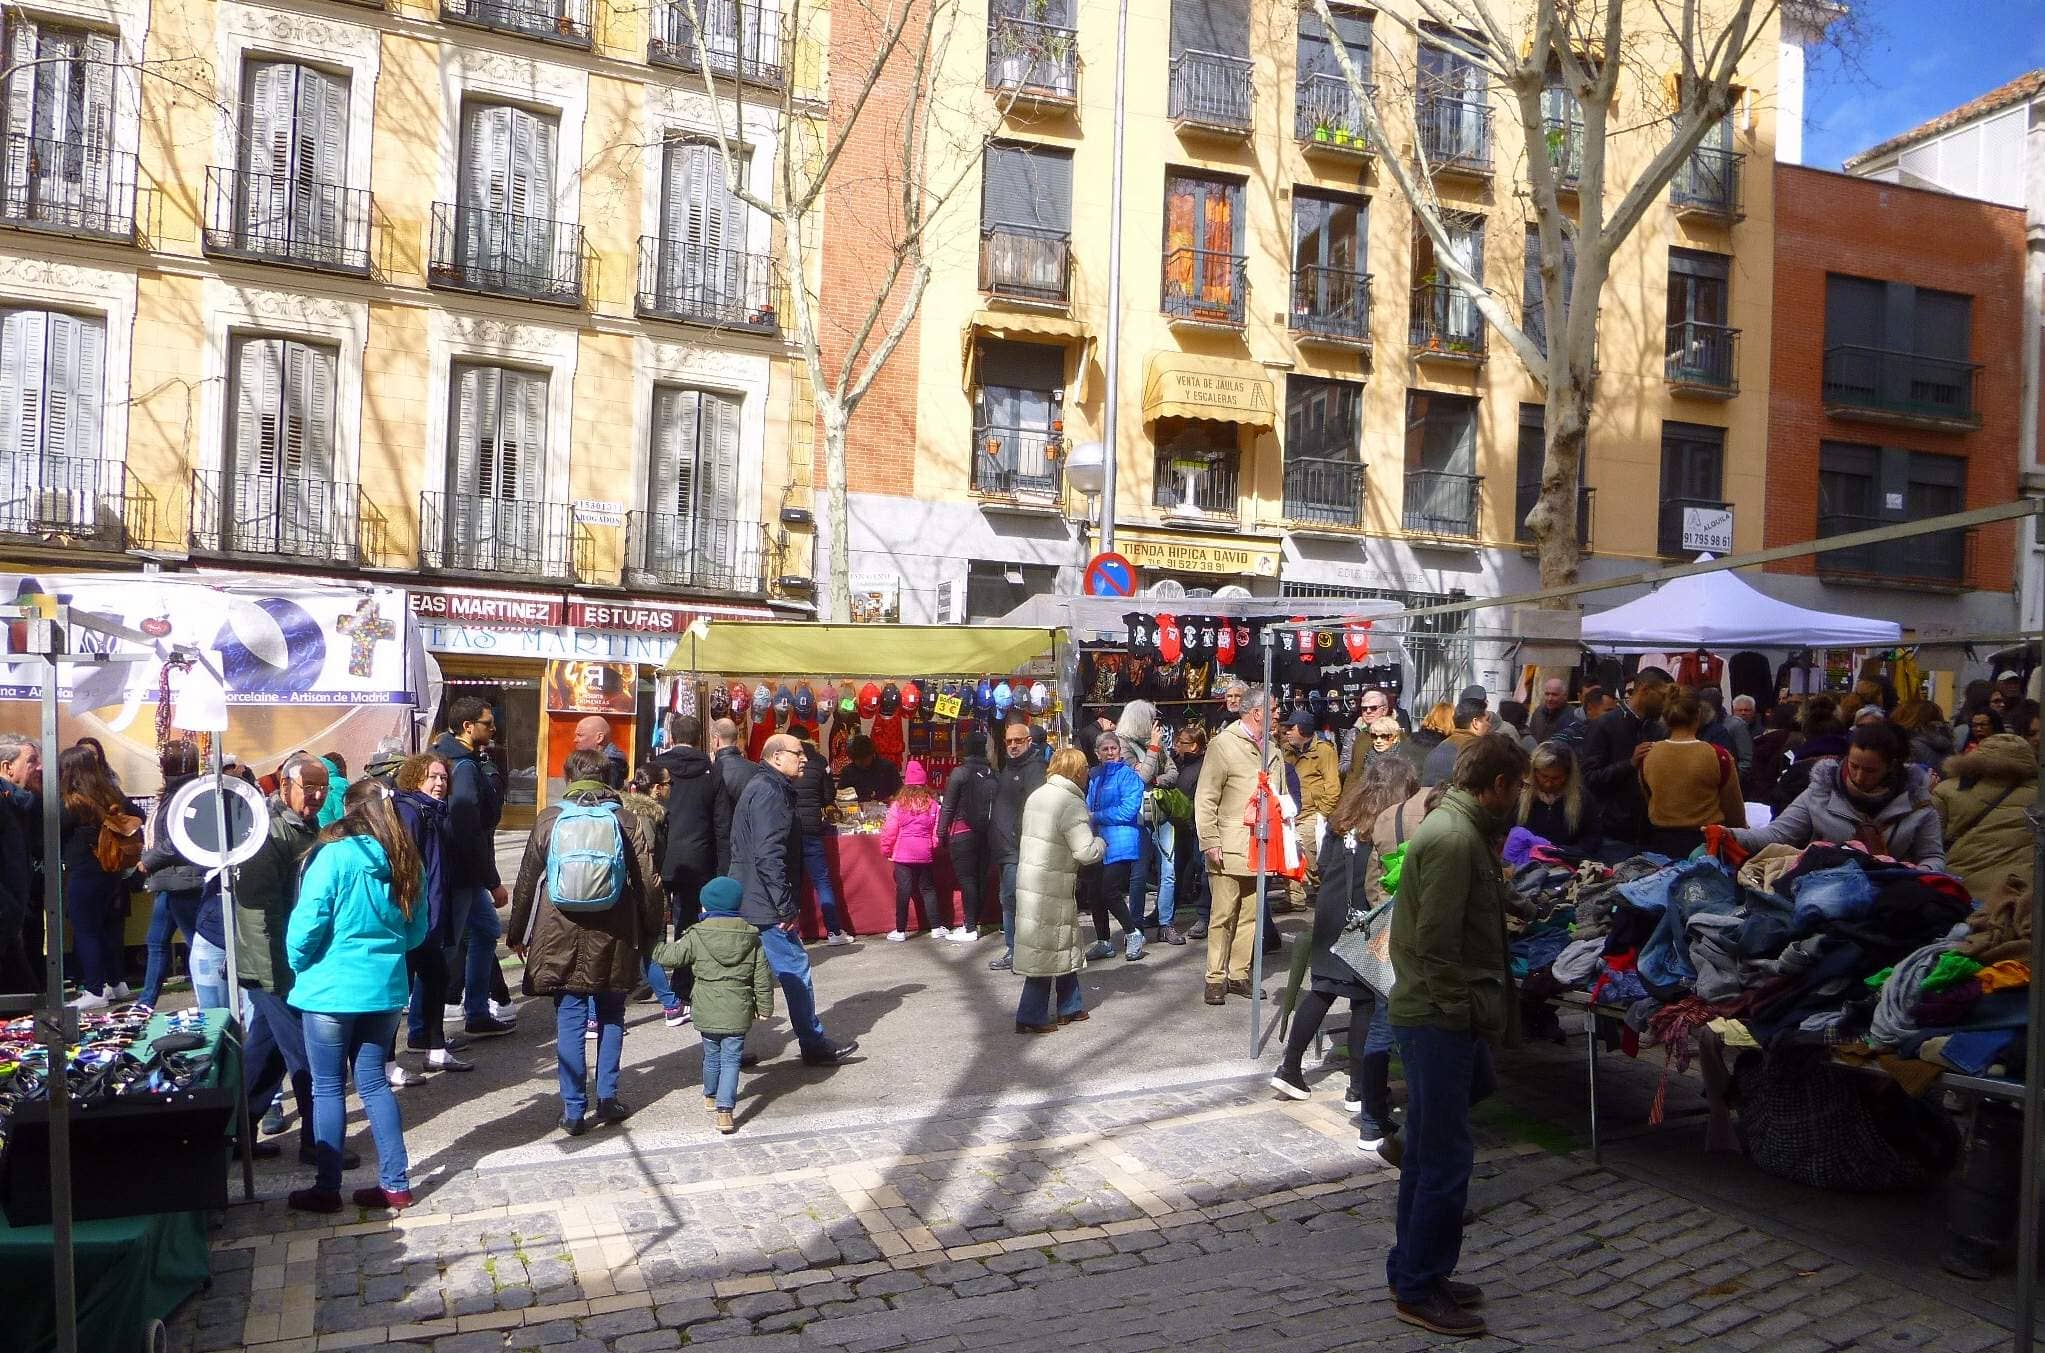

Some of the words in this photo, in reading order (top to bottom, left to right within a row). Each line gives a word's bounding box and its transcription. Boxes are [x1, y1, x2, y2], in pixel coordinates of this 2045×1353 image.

[1176, 375, 1201, 387] VENTA
[1203, 378, 1213, 389] DE
[1215, 380, 1244, 393] JAULAS
[1185, 390, 1190, 400] Y
[1193, 391, 1237, 405] ESCALERAS
[1703, 513, 1730, 532] ALQUILA
[1684, 532, 1692, 543] 91
[1694, 533, 1709, 545] 795
[1123, 543, 1165, 558] TIENDA
[1168, 546, 1207, 560] HIPICA
[1213, 550, 1248, 564] DAVID
[1167, 559, 1176, 568] 91
[1178, 560, 1198, 569] 527
[1200, 561, 1213, 571] 38
[1215, 562, 1225, 572] 91
[451, 597, 549, 620] MARTINEZ
[584, 606, 673, 628] ESTUFAS
[418, 623, 497, 649] EAS
[522, 628, 682, 659] MARTINE
[290, 691, 330, 702] Artisan
[333, 691, 347, 702] de
[350, 691, 390, 702] Madrid
[939, 702, 946, 712] 3
